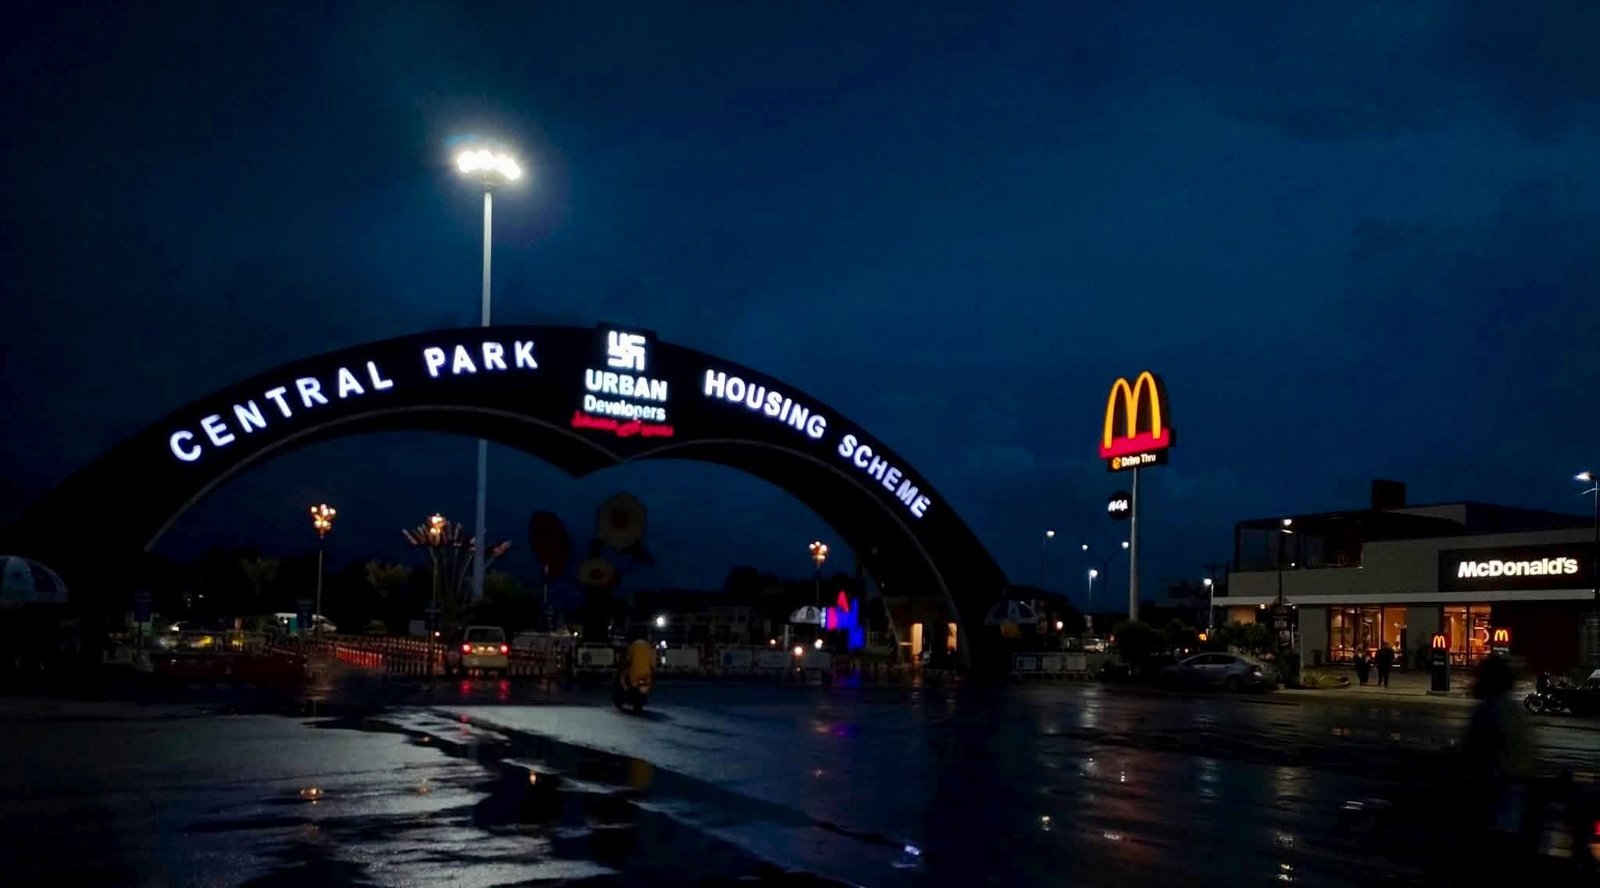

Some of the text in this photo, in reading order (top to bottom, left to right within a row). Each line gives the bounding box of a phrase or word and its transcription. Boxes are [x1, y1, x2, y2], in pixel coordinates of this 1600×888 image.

[585, 368, 667, 400] URBAN
[169, 340, 538, 461] CENTRAL PARK
[583, 394, 665, 420] Developers
[703, 368, 931, 518] HOUSING SCHEME
[1121, 453, 1156, 466] Drive Thru
[1457, 556, 1578, 578] McDonald's
